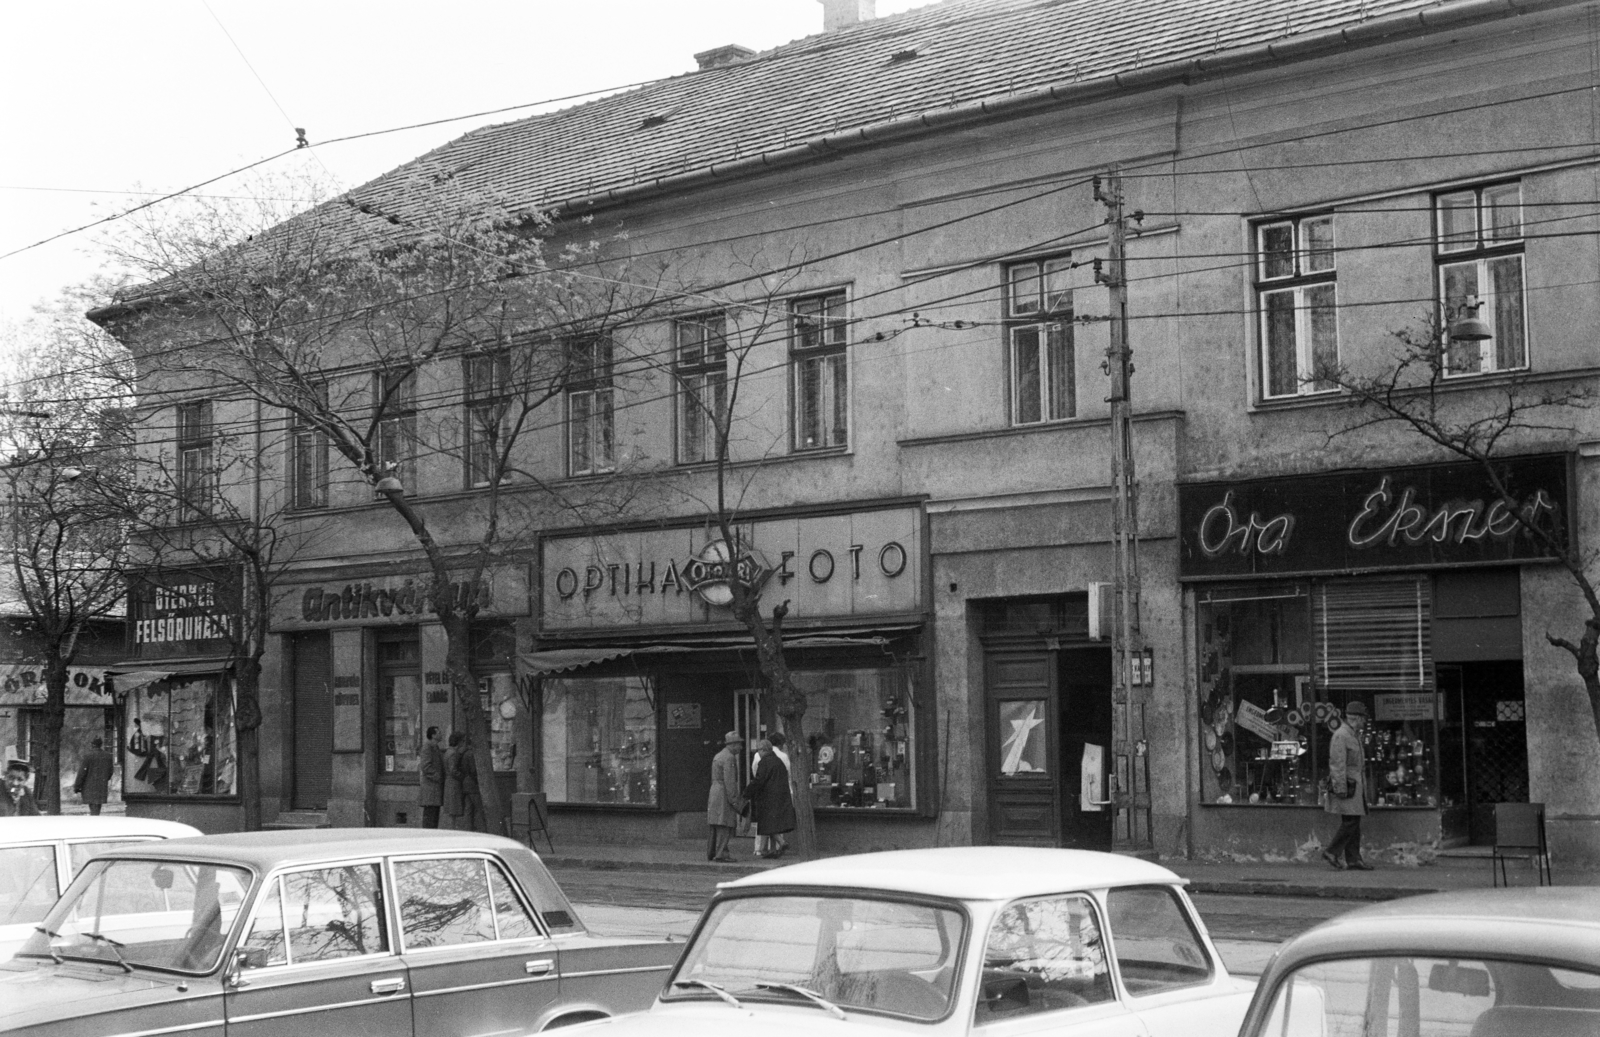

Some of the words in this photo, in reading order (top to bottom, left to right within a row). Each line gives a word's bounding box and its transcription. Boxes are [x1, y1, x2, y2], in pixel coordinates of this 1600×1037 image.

[1199, 490, 1294, 556] Óra
[1348, 475, 1555, 547] Ékszer
[555, 557, 684, 600] OPTIKA
[778, 541, 907, 586] FOTO
